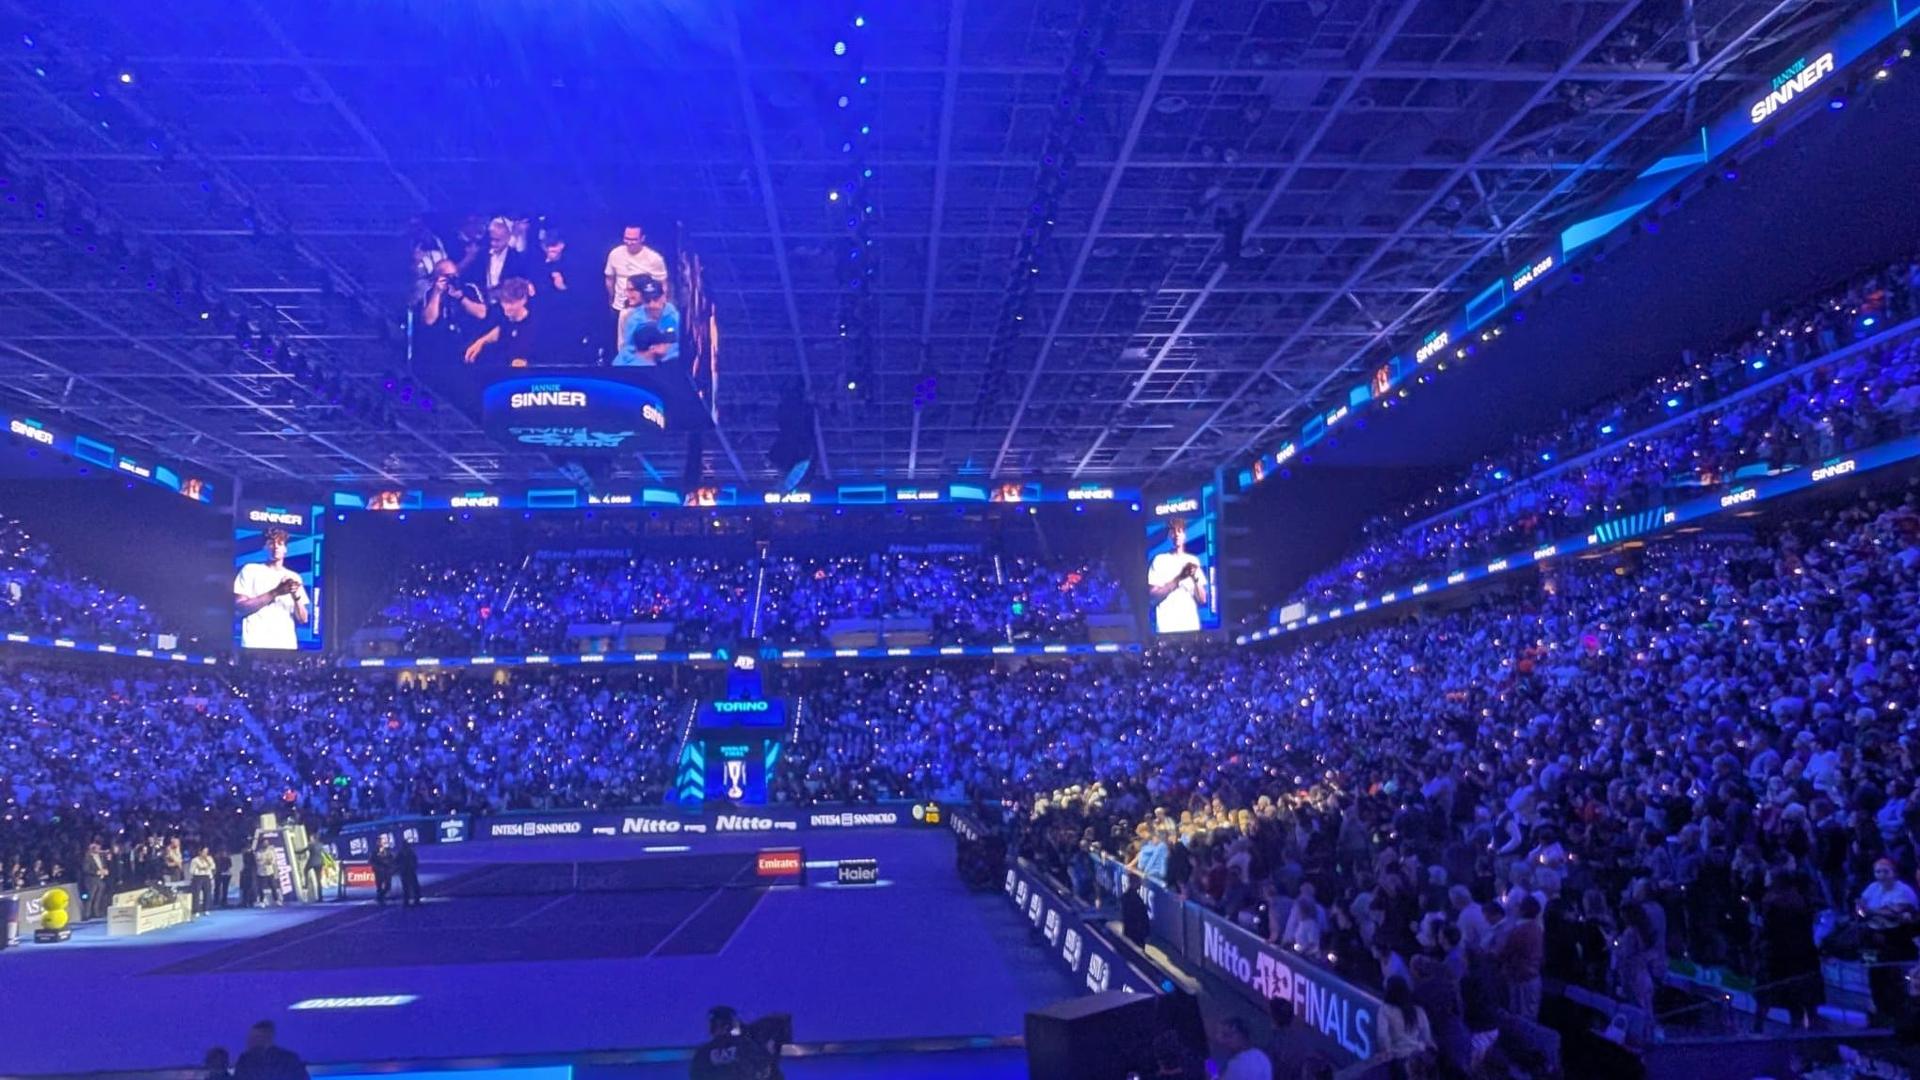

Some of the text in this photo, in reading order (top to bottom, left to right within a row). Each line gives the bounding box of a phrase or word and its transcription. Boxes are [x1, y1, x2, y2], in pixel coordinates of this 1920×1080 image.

[1751, 52, 1834, 124] SINNER
[1416, 332, 1448, 364] SINNER
[511, 391, 586, 409] SINNER
[10, 420, 54, 445] SINNER
[1811, 460, 1856, 481] SINNER
[452, 496, 499, 508] SINNER
[1067, 489, 1114, 500] SINNER
[1720, 489, 1756, 507] SINNER
[1155, 499, 1198, 515] SINNER
[249, 510, 303, 526] SINNER
[714, 702, 769, 713] TORINO
[622, 817, 680, 834] Nitto
[715, 815, 773, 831] Nitto
[758, 858, 799, 870] Emirates
[838, 867, 877, 881] Haier
[1203, 920, 1251, 983] Nitto
[1293, 972, 1371, 1060] FINALS
